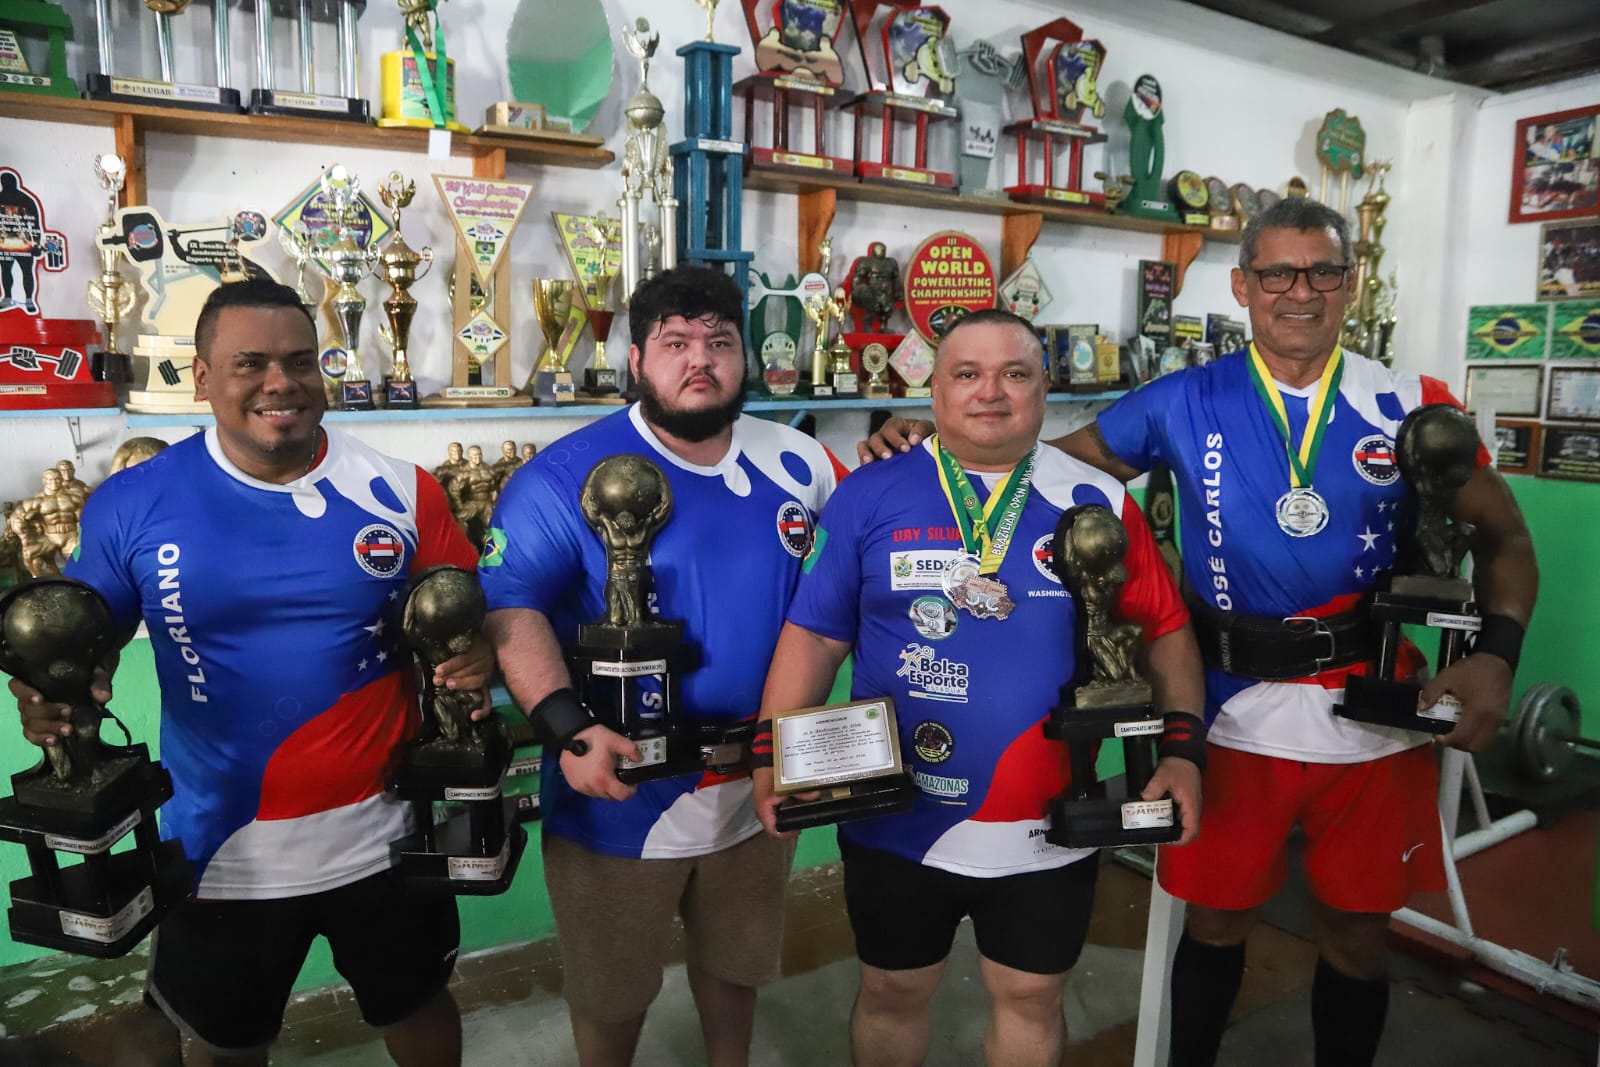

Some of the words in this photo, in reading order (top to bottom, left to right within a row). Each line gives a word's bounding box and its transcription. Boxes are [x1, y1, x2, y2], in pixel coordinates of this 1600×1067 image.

[143, 87, 171, 96] LUGAR
[947, 237, 957, 245] III
[930, 245, 972, 259] OPEN
[921, 260, 985, 275] WORLD
[914, 277, 991, 287] POWERLIFTING
[911, 288, 992, 298] CHAMPIONSHIPS
[1203, 432, 1223, 548] CARLOS
[1010, 487, 1027, 509] OPEN
[1208, 555, 1233, 612] OSÉ
[158, 543, 208, 703] FLORIANO
[920, 657, 967, 676] Bolsa
[909, 670, 967, 687] Esporte
[926, 685, 967, 695] ESTADUAL
[1120, 725, 1147, 733] CAMPEONATO
[52, 838, 78, 849] CAMPEONATO
